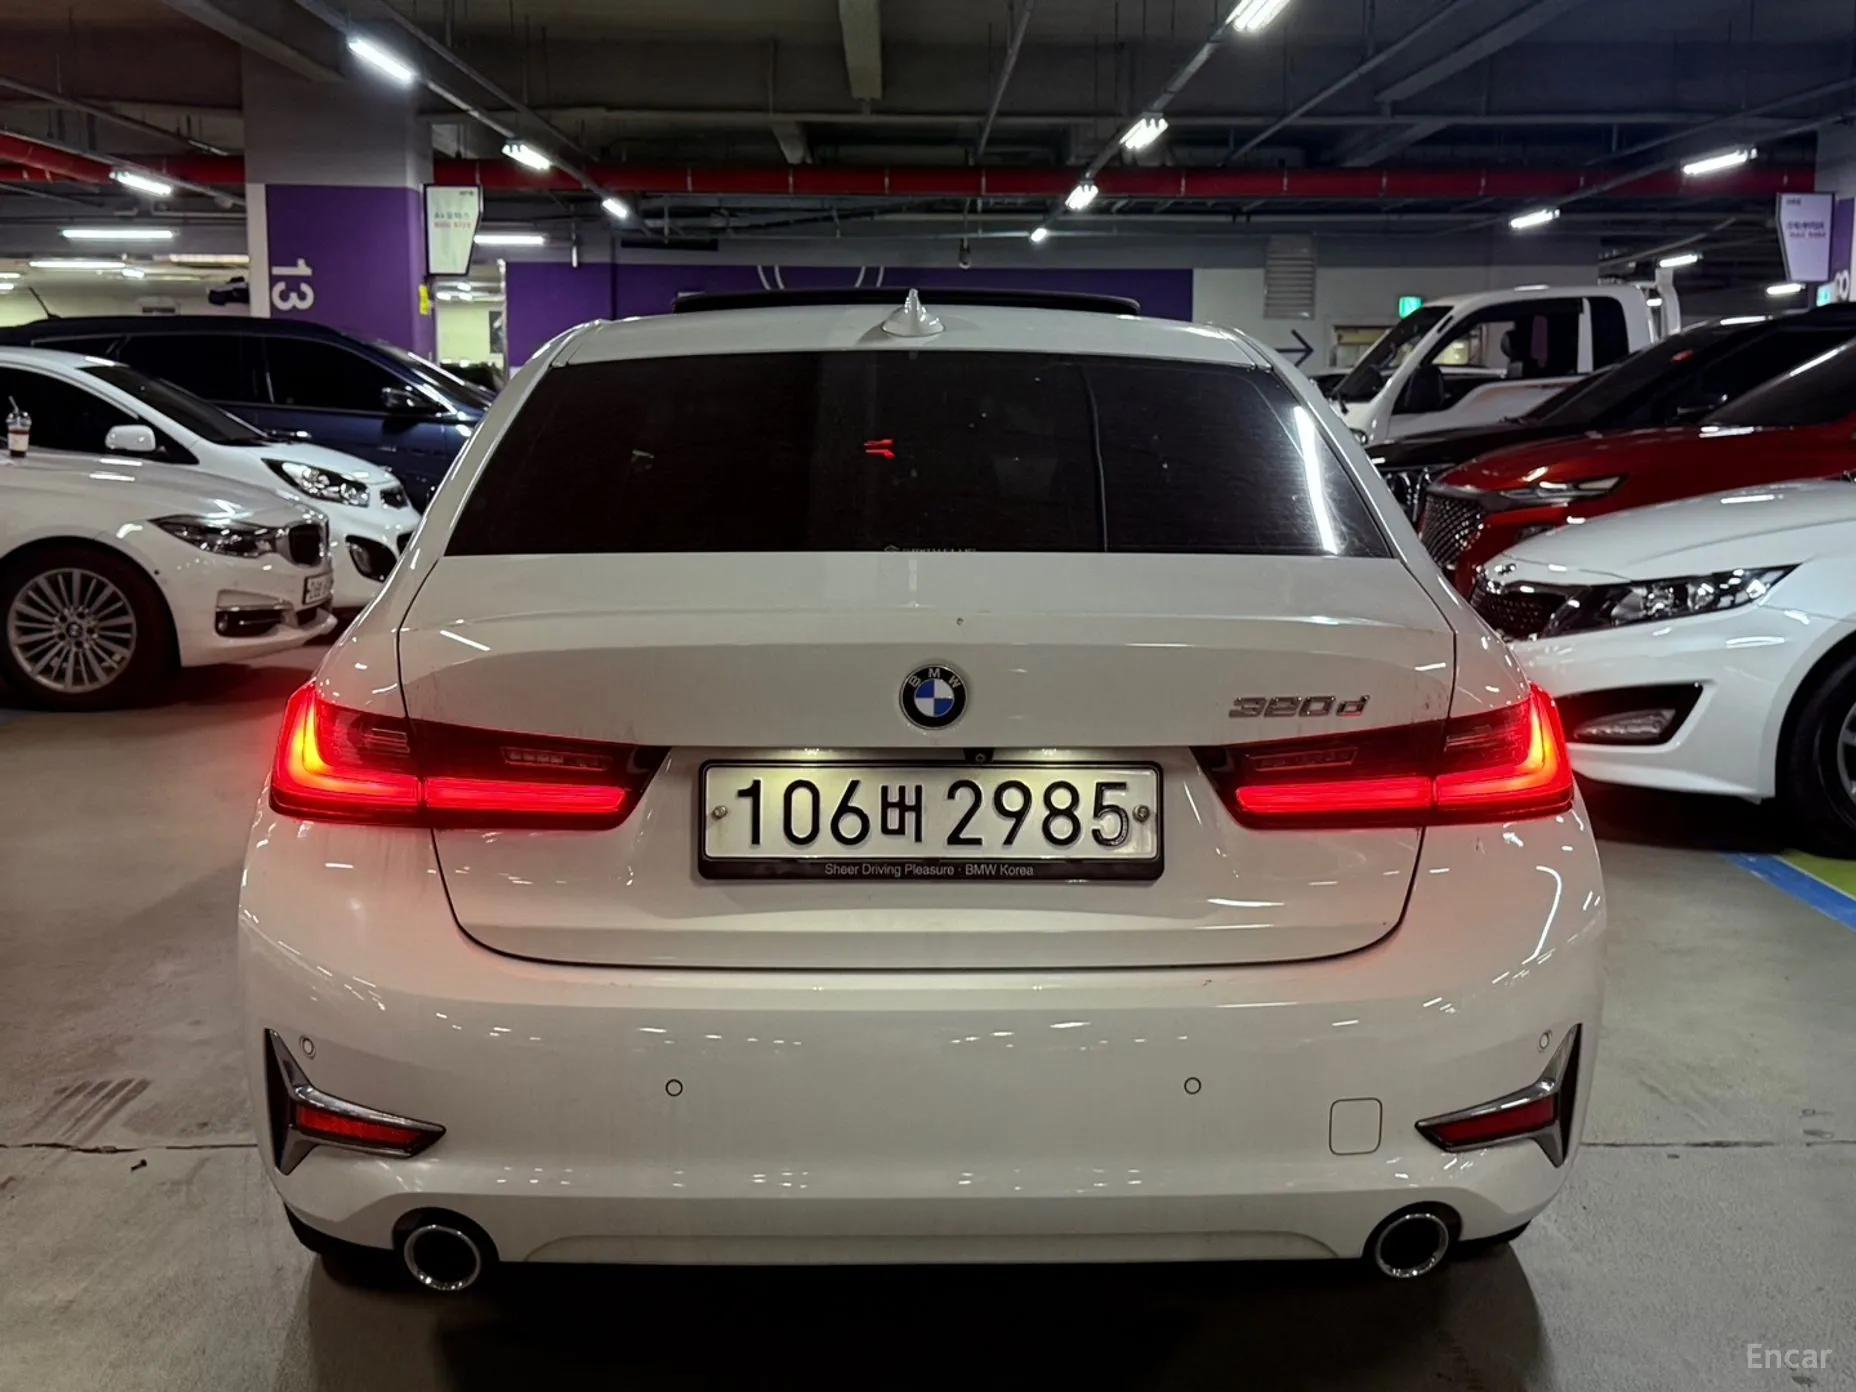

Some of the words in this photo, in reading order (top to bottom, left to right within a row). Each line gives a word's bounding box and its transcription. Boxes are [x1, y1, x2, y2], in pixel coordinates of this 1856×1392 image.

[271, 257, 315, 311] 13
[908, 667, 961, 688] BMW
[1228, 694, 1371, 718] 320d
[737, 779, 923, 846] 106버
[946, 779, 1131, 846] 2985
[824, 862, 860, 876] Sheer
[862, 863, 901, 878] Driving
[904, 863, 955, 876] Pleasure
[965, 864, 997, 876] BMW
[1000, 864, 1034, 876] Korea
